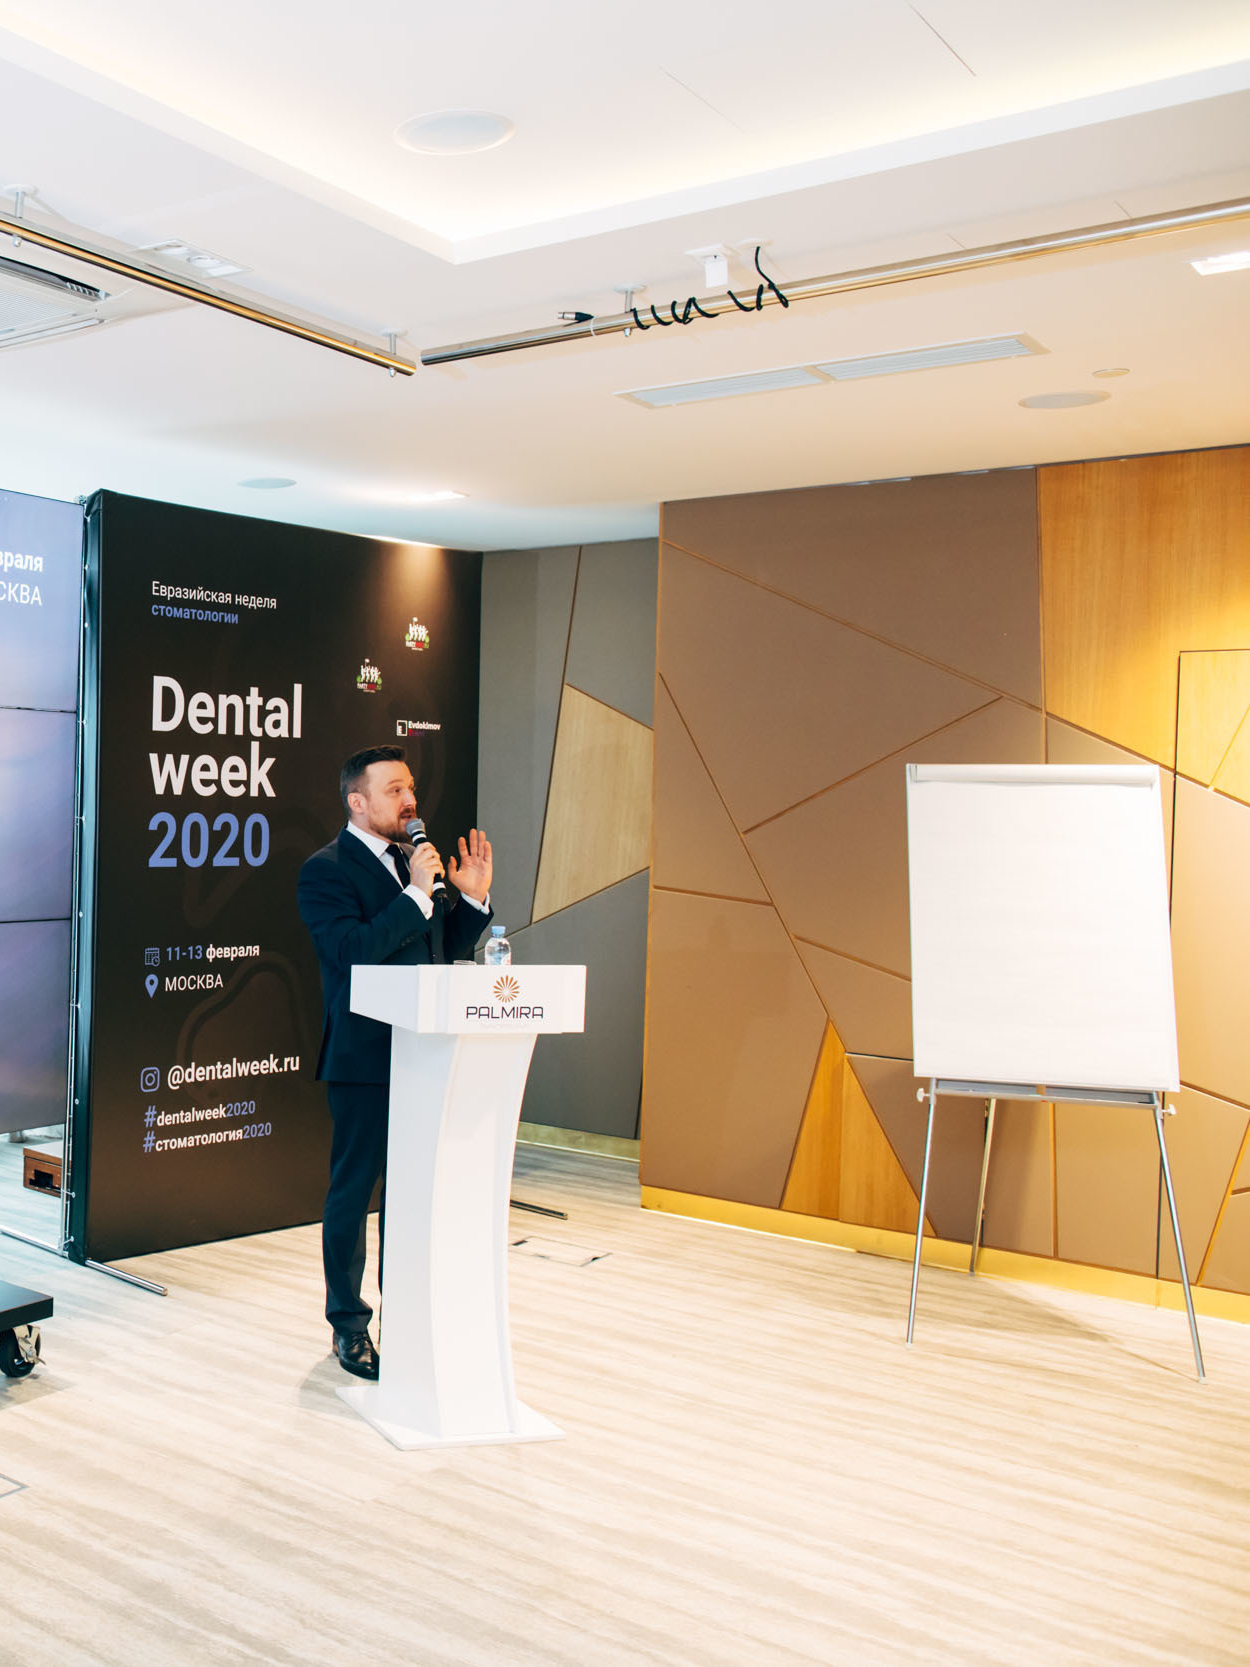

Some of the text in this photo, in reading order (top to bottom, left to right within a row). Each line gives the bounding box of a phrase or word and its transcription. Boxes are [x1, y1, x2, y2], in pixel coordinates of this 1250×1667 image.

[152, 580, 277, 609] Евразийская неделя
[151, 604, 239, 624] стоматологии
[152, 675, 302, 738] Dental
[149, 741, 276, 797] week
[148, 812, 270, 868] 2020
[166, 943, 260, 963] 11-13 февраля
[165, 974, 224, 992] МОСКВА
[466, 1006, 544, 1019] PALMIRA
[167, 1054, 300, 1090] @dentalweek.ru
[144, 1100, 256, 1127] #dentalweek2020
[143, 1122, 272, 1152] #стоматология2020
